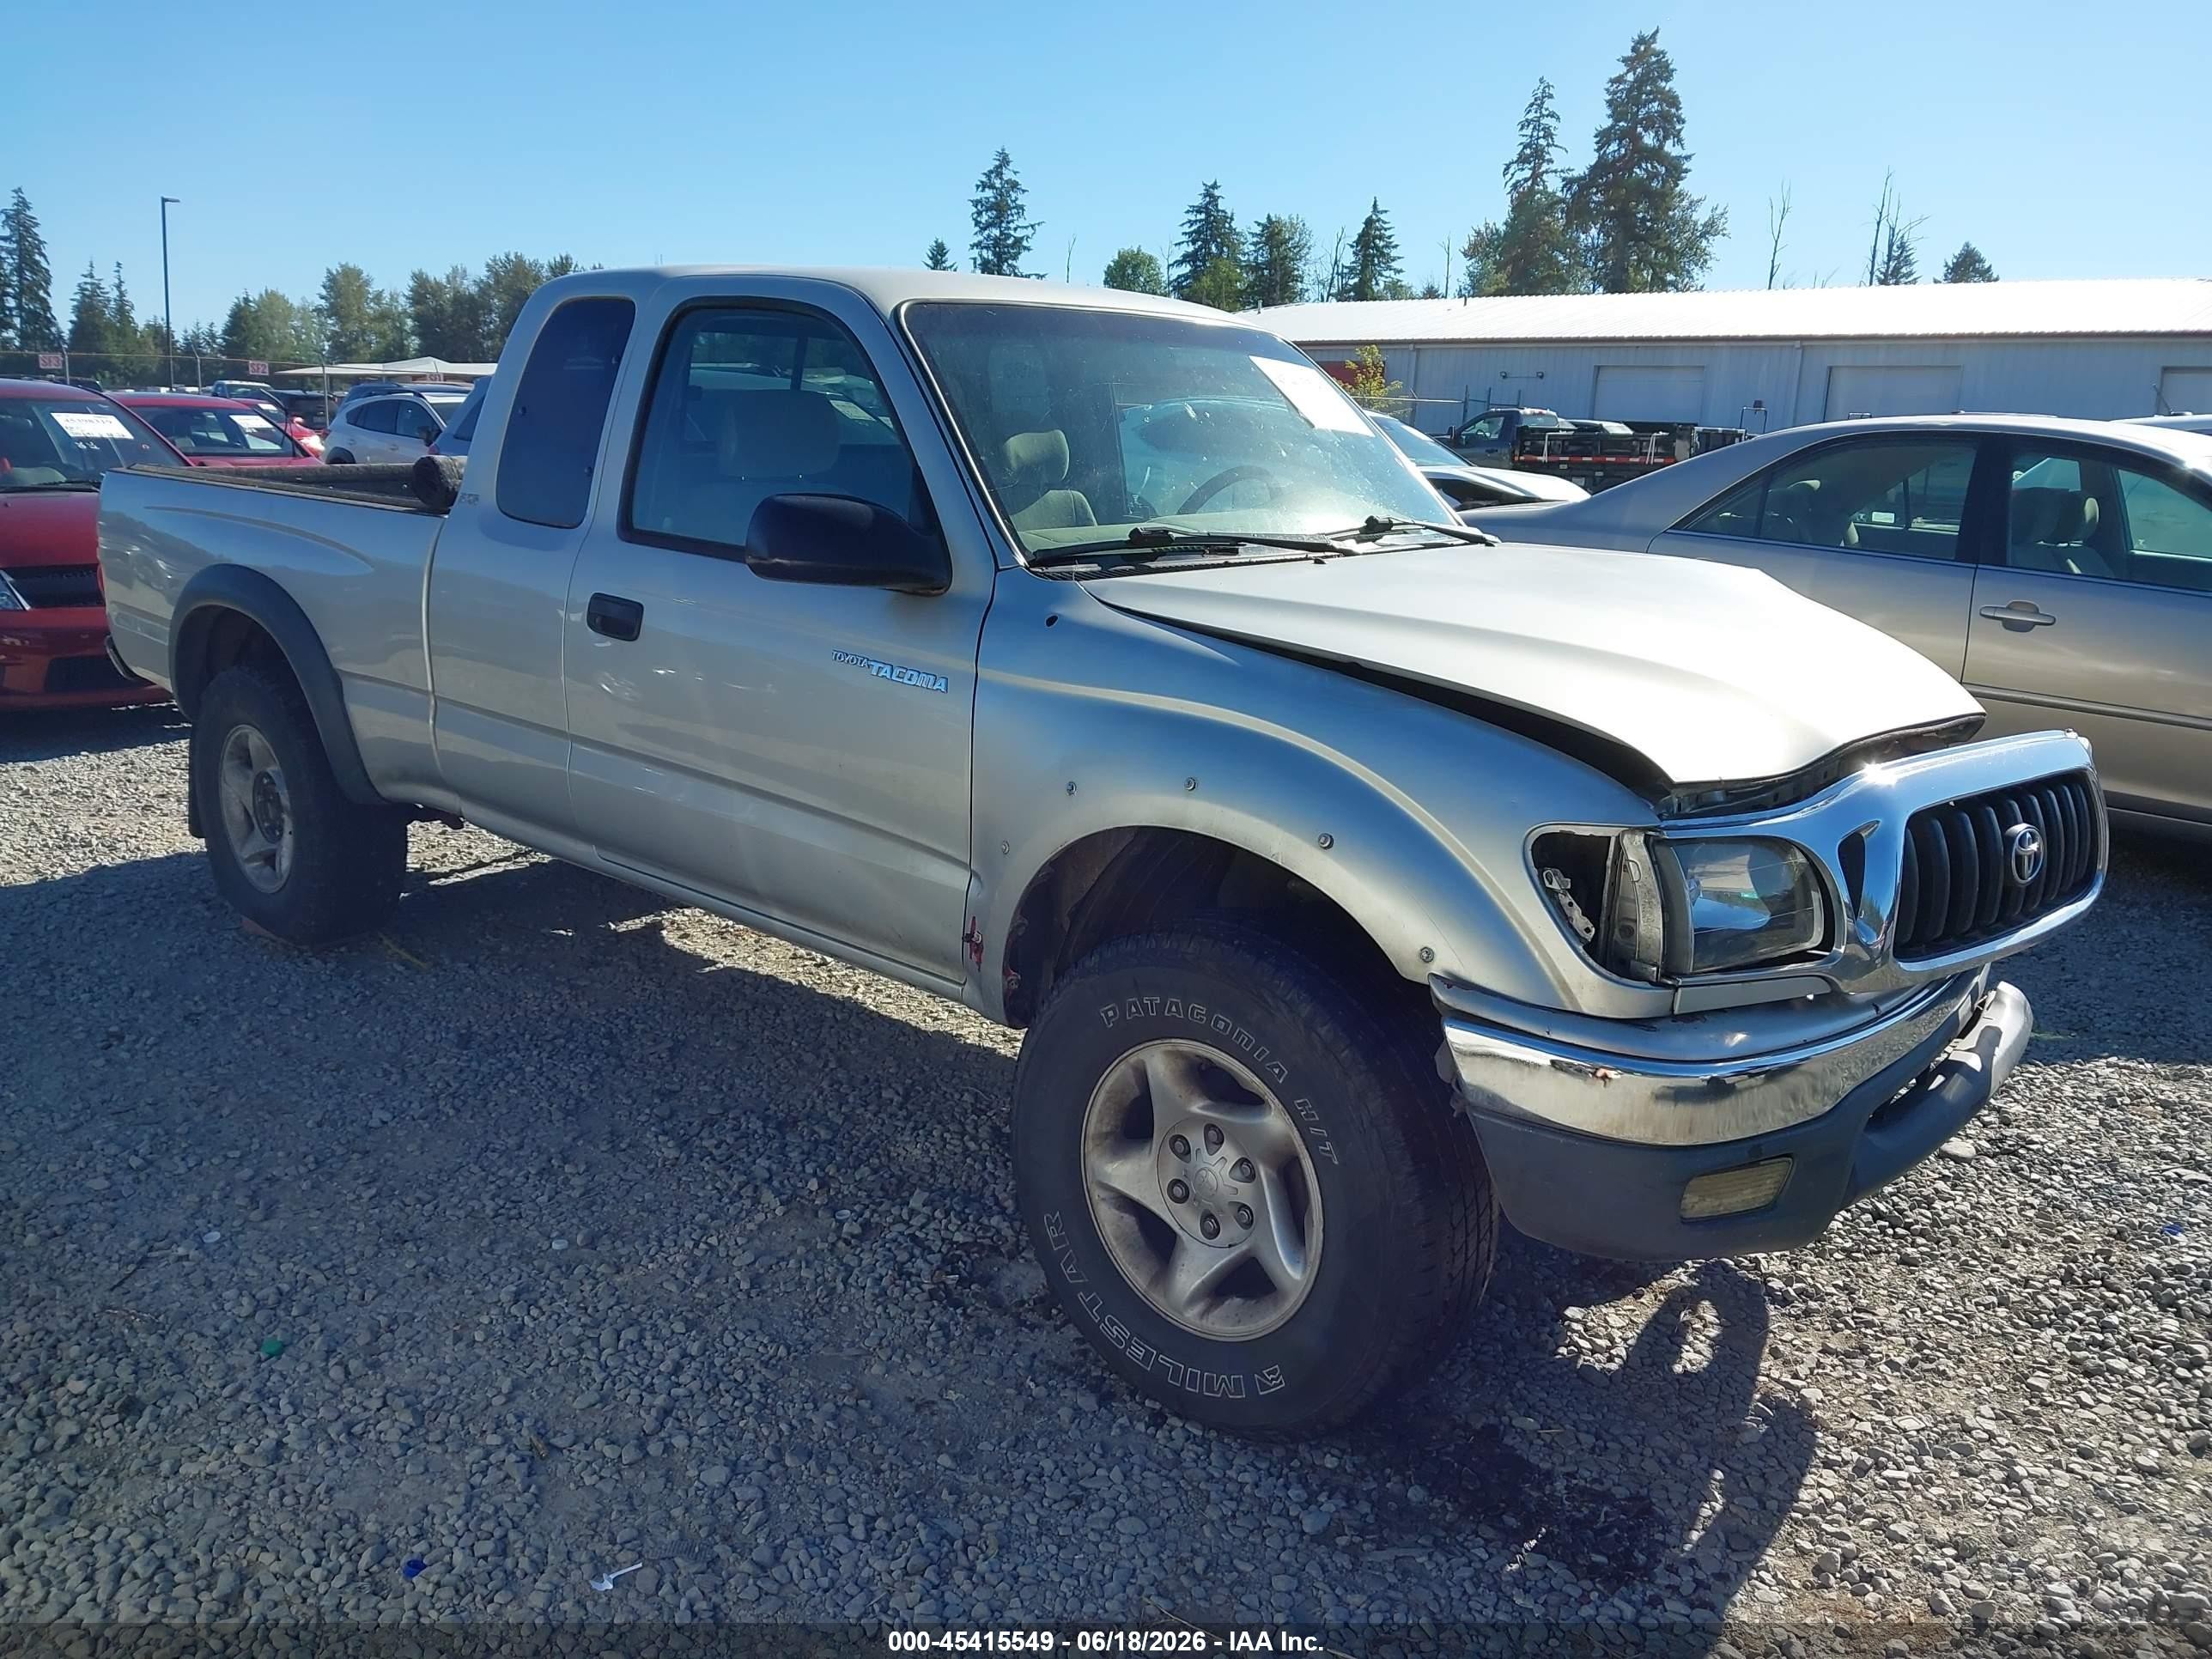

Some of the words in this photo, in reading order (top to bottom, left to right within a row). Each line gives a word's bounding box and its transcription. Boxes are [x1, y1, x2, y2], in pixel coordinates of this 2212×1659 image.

[250, 363, 267, 374] SF2
[831, 650, 869, 668] TOYOTA
[870, 659, 949, 693] TACOMA
[1099, 995, 1288, 1084] PATAGONIA
[1042, 1211, 1247, 1399] MILESTAR
